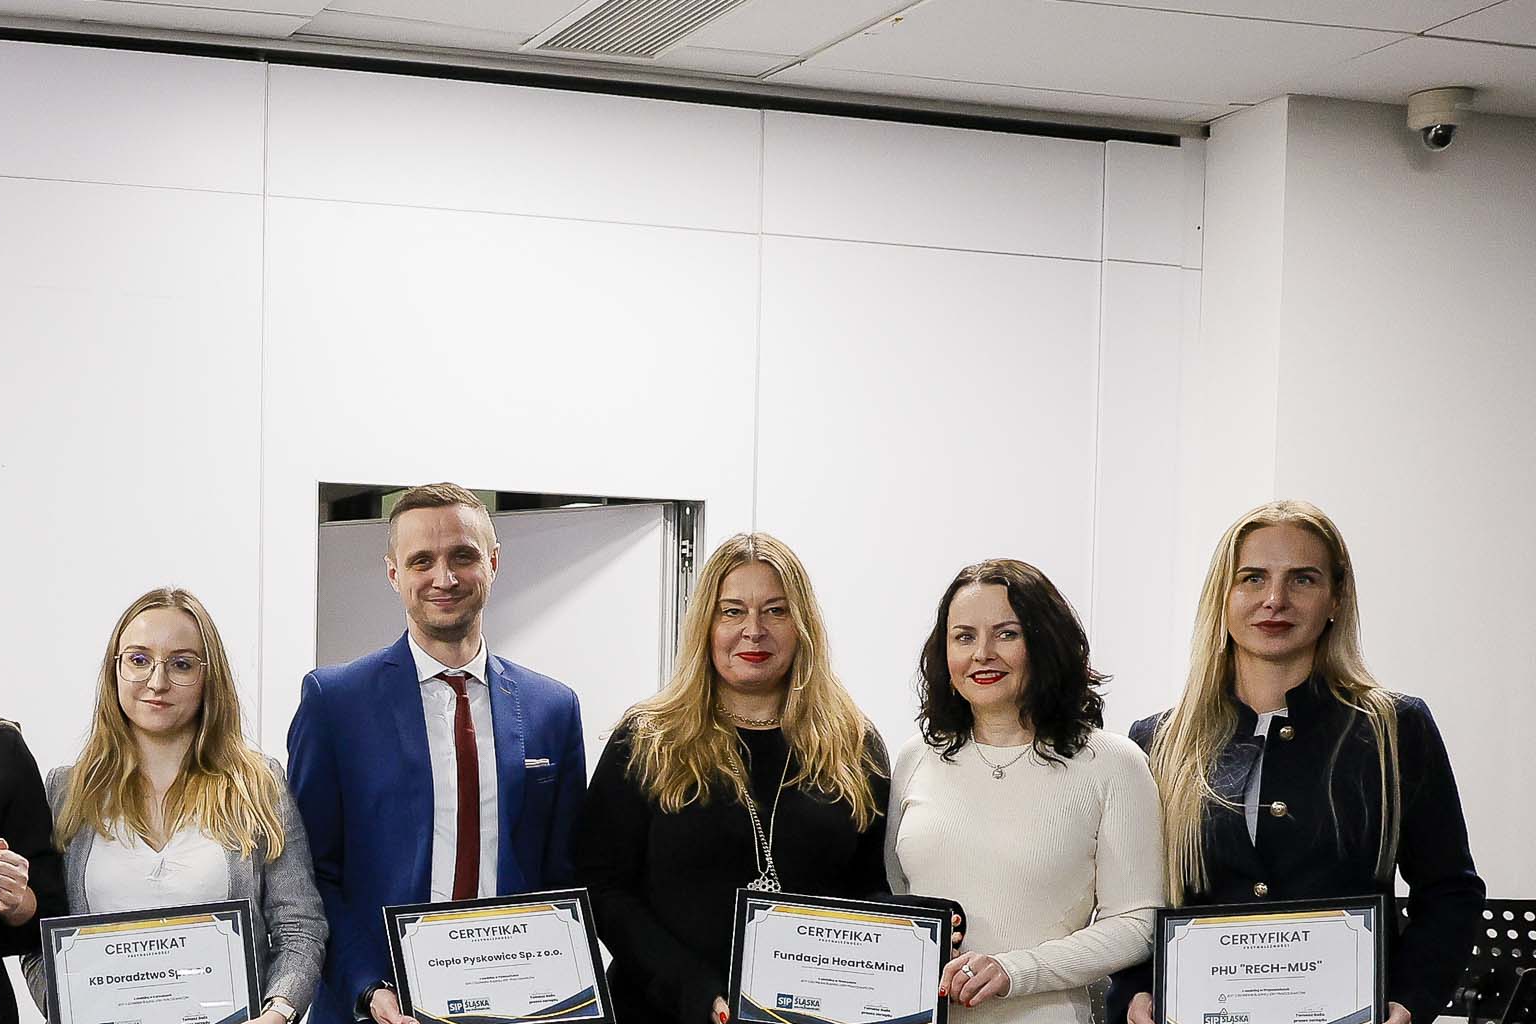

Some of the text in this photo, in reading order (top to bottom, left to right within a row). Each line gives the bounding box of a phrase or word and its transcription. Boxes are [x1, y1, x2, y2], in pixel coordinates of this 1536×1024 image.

[448, 923, 528, 940] CERTYFIKAT
[796, 925, 882, 944] CERTYFIKAT
[1219, 930, 1311, 946] CERTYFIKAT
[104, 936, 187, 955] CERTYFIKAT
[428, 955, 462, 968] Ciepło
[463, 951, 518, 966] Pyskowice
[519, 950, 536, 961] Sp.
[544, 949, 563, 957] o.o.
[773, 950, 905, 973] Fundacja Heart&Mind
[1211, 960, 1323, 976] PHU "RECH-MUS"
[89, 976, 104, 986] KB
[106, 970, 167, 985] Doradztwo
[448, 1002, 463, 1013] SIP
[777, 996, 793, 1007] SIP
